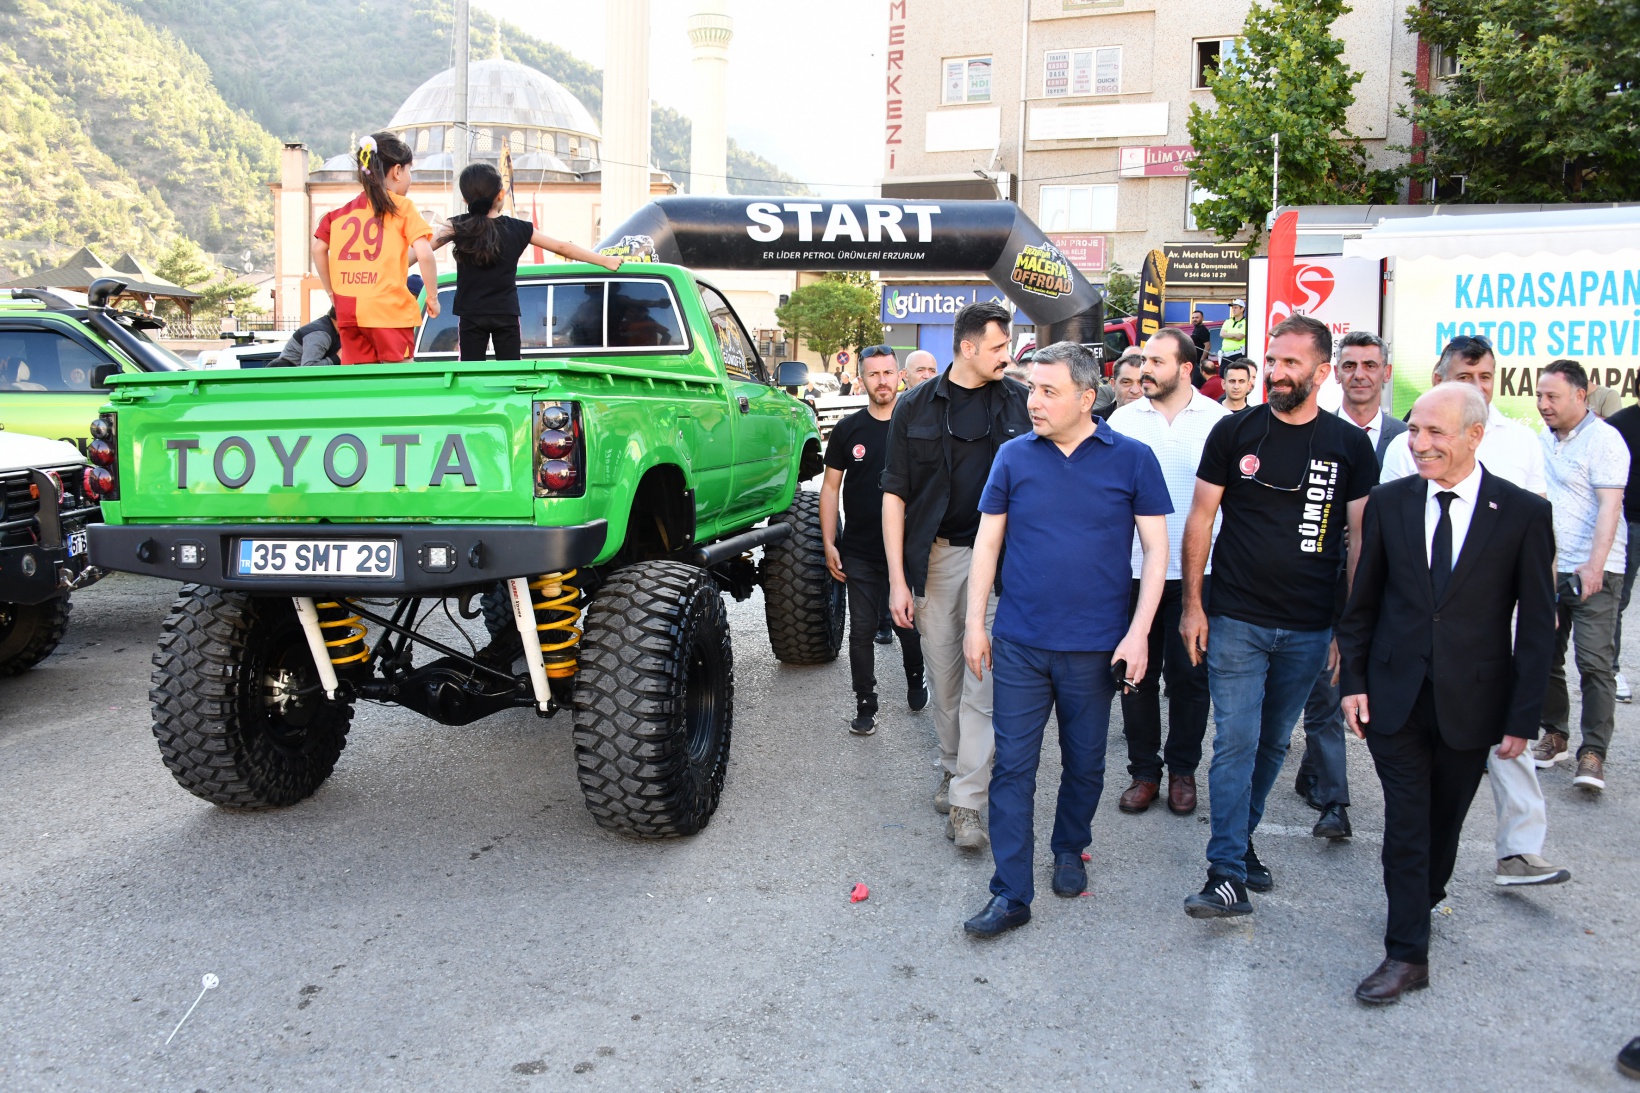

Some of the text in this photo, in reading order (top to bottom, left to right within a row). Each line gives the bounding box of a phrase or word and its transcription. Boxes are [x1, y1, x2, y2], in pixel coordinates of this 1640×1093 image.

[886, 0, 906, 169] MERKEZİ
[1096, 85, 1119, 93] ERGO
[1146, 148, 1173, 164] İLİM
[746, 202, 941, 243] START
[337, 216, 384, 261] 29
[763, 250, 925, 259] ER LİDER PETROL ÜRÜNLERİ ERZURUM
[1016, 253, 1068, 279] MACERA
[1168, 250, 1180, 259] Av.
[1182, 250, 1219, 259] Metehan
[1201, 262, 1239, 270] Danışmanlık
[340, 271, 378, 284] TUSEM
[1012, 268, 1072, 293] OFFROAD
[1455, 269, 1640, 309] KARASAPAN
[1141, 280, 1160, 348] OFF
[166, 433, 478, 489] TOYOTA
[1329, 461, 1339, 485] Road
[1298, 459, 1331, 553] GÜMOFF
[241, 544, 391, 573] TR 35 SMT 29
